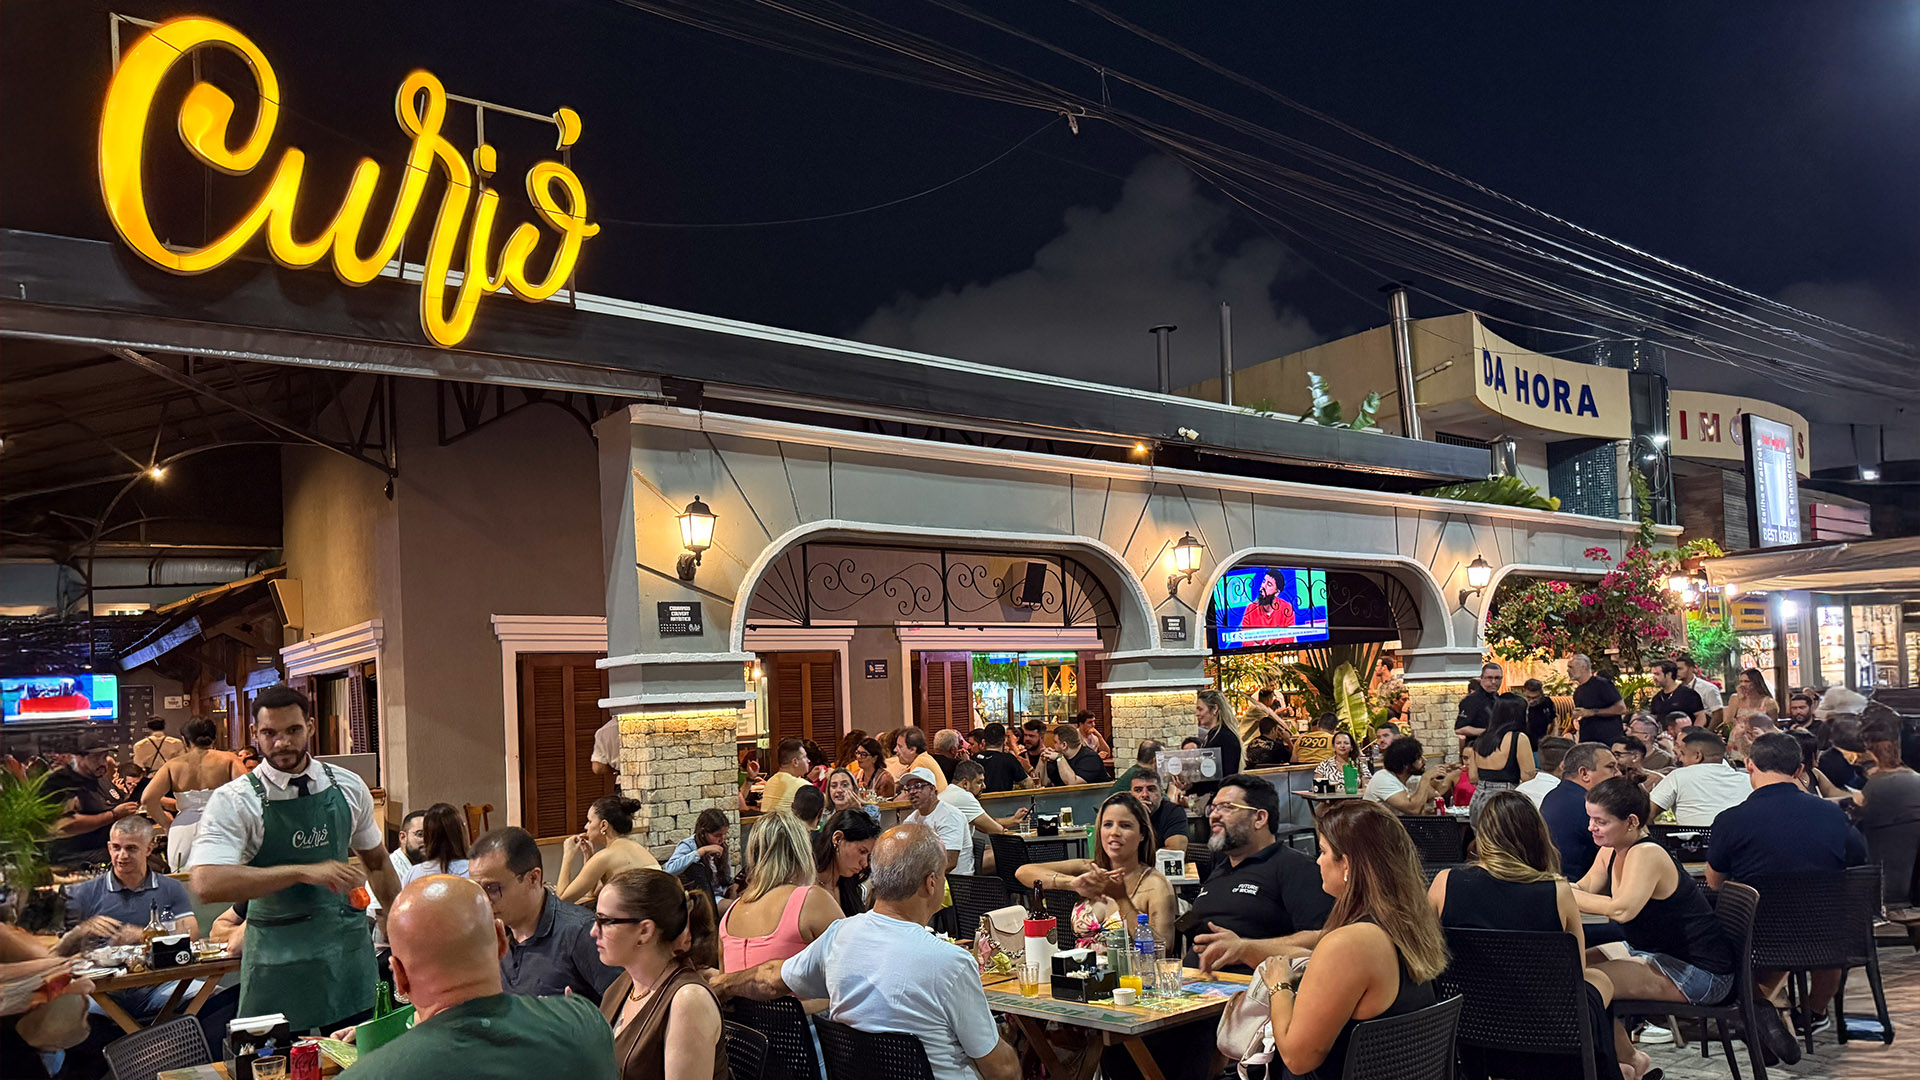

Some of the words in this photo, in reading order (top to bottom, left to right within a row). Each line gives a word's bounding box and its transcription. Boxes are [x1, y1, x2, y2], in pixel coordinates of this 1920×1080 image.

[99, 16, 600, 347] Curió
[1482, 348, 1508, 395] DA
[1515, 366, 1599, 418] HORA
[1679, 408, 1805, 460] IMÓS
[1763, 528, 1778, 543] BEST
[1779, 530, 1798, 544] KEBAB
[1301, 737, 1327, 748] 1990
[292, 823, 328, 848] Curió
[177, 953, 189, 962] 38
